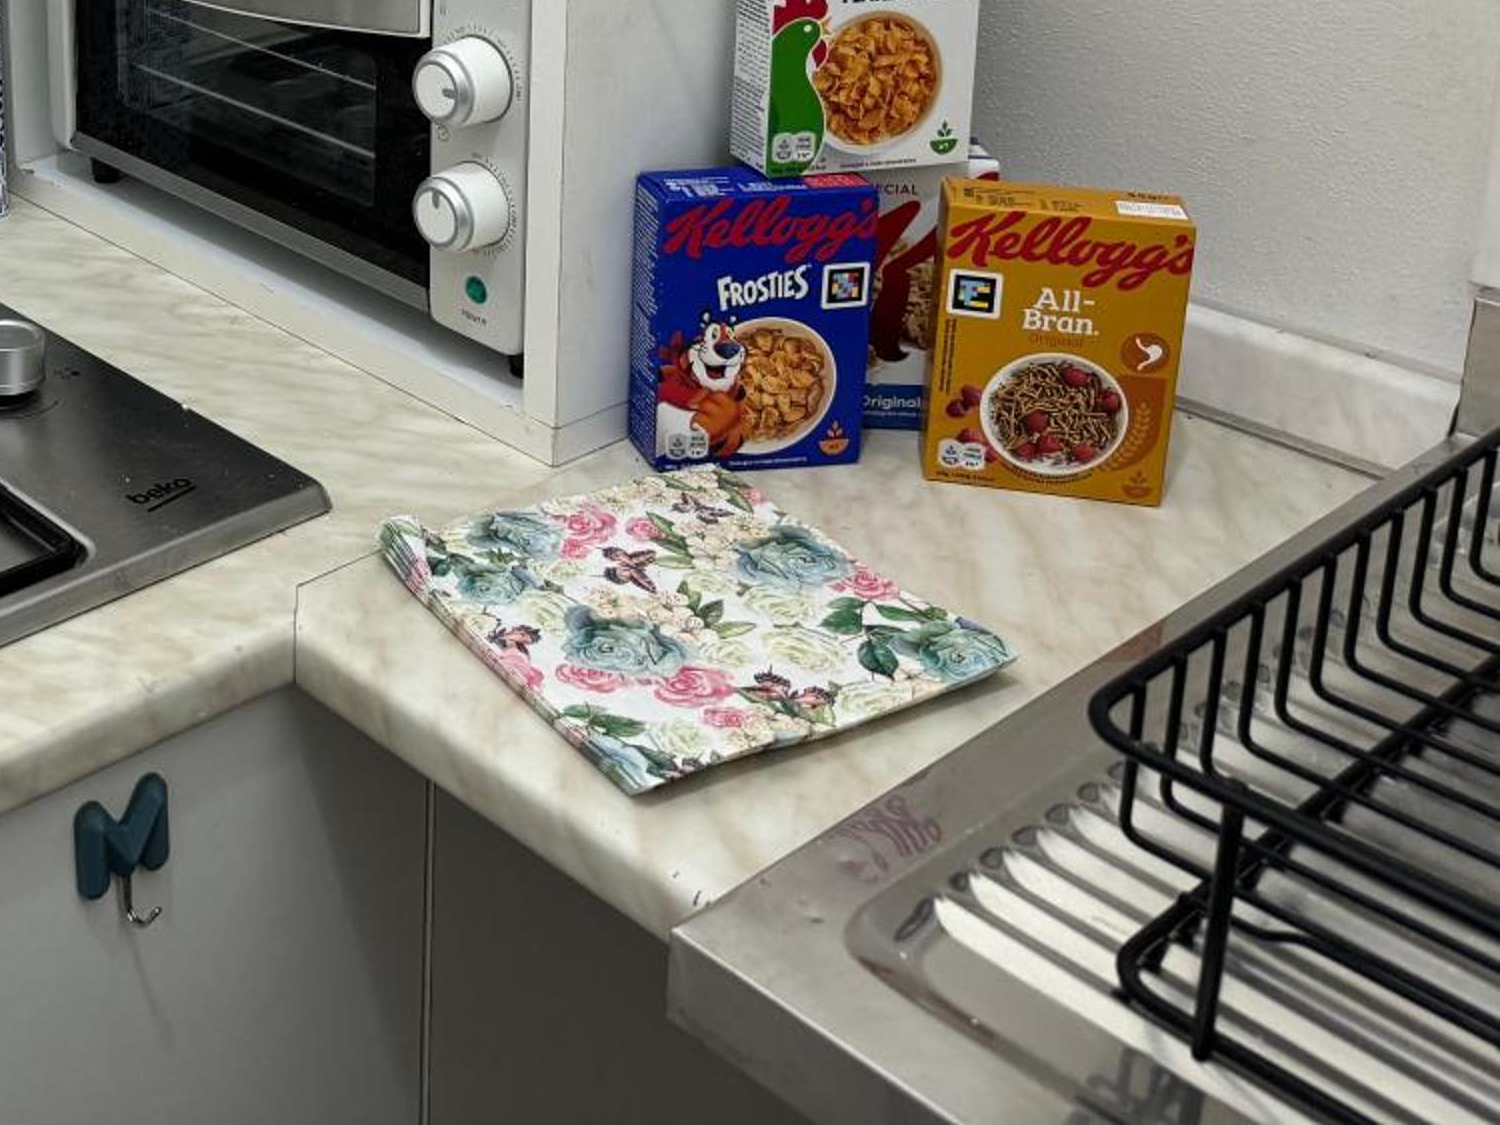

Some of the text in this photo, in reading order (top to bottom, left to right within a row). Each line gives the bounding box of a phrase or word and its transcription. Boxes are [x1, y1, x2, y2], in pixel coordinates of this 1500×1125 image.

[663, 195, 878, 263] Kellogg's
[946, 210, 1195, 291] Kellogg's
[717, 265, 810, 311] FROSTIES
[1033, 286, 1097, 313] All-
